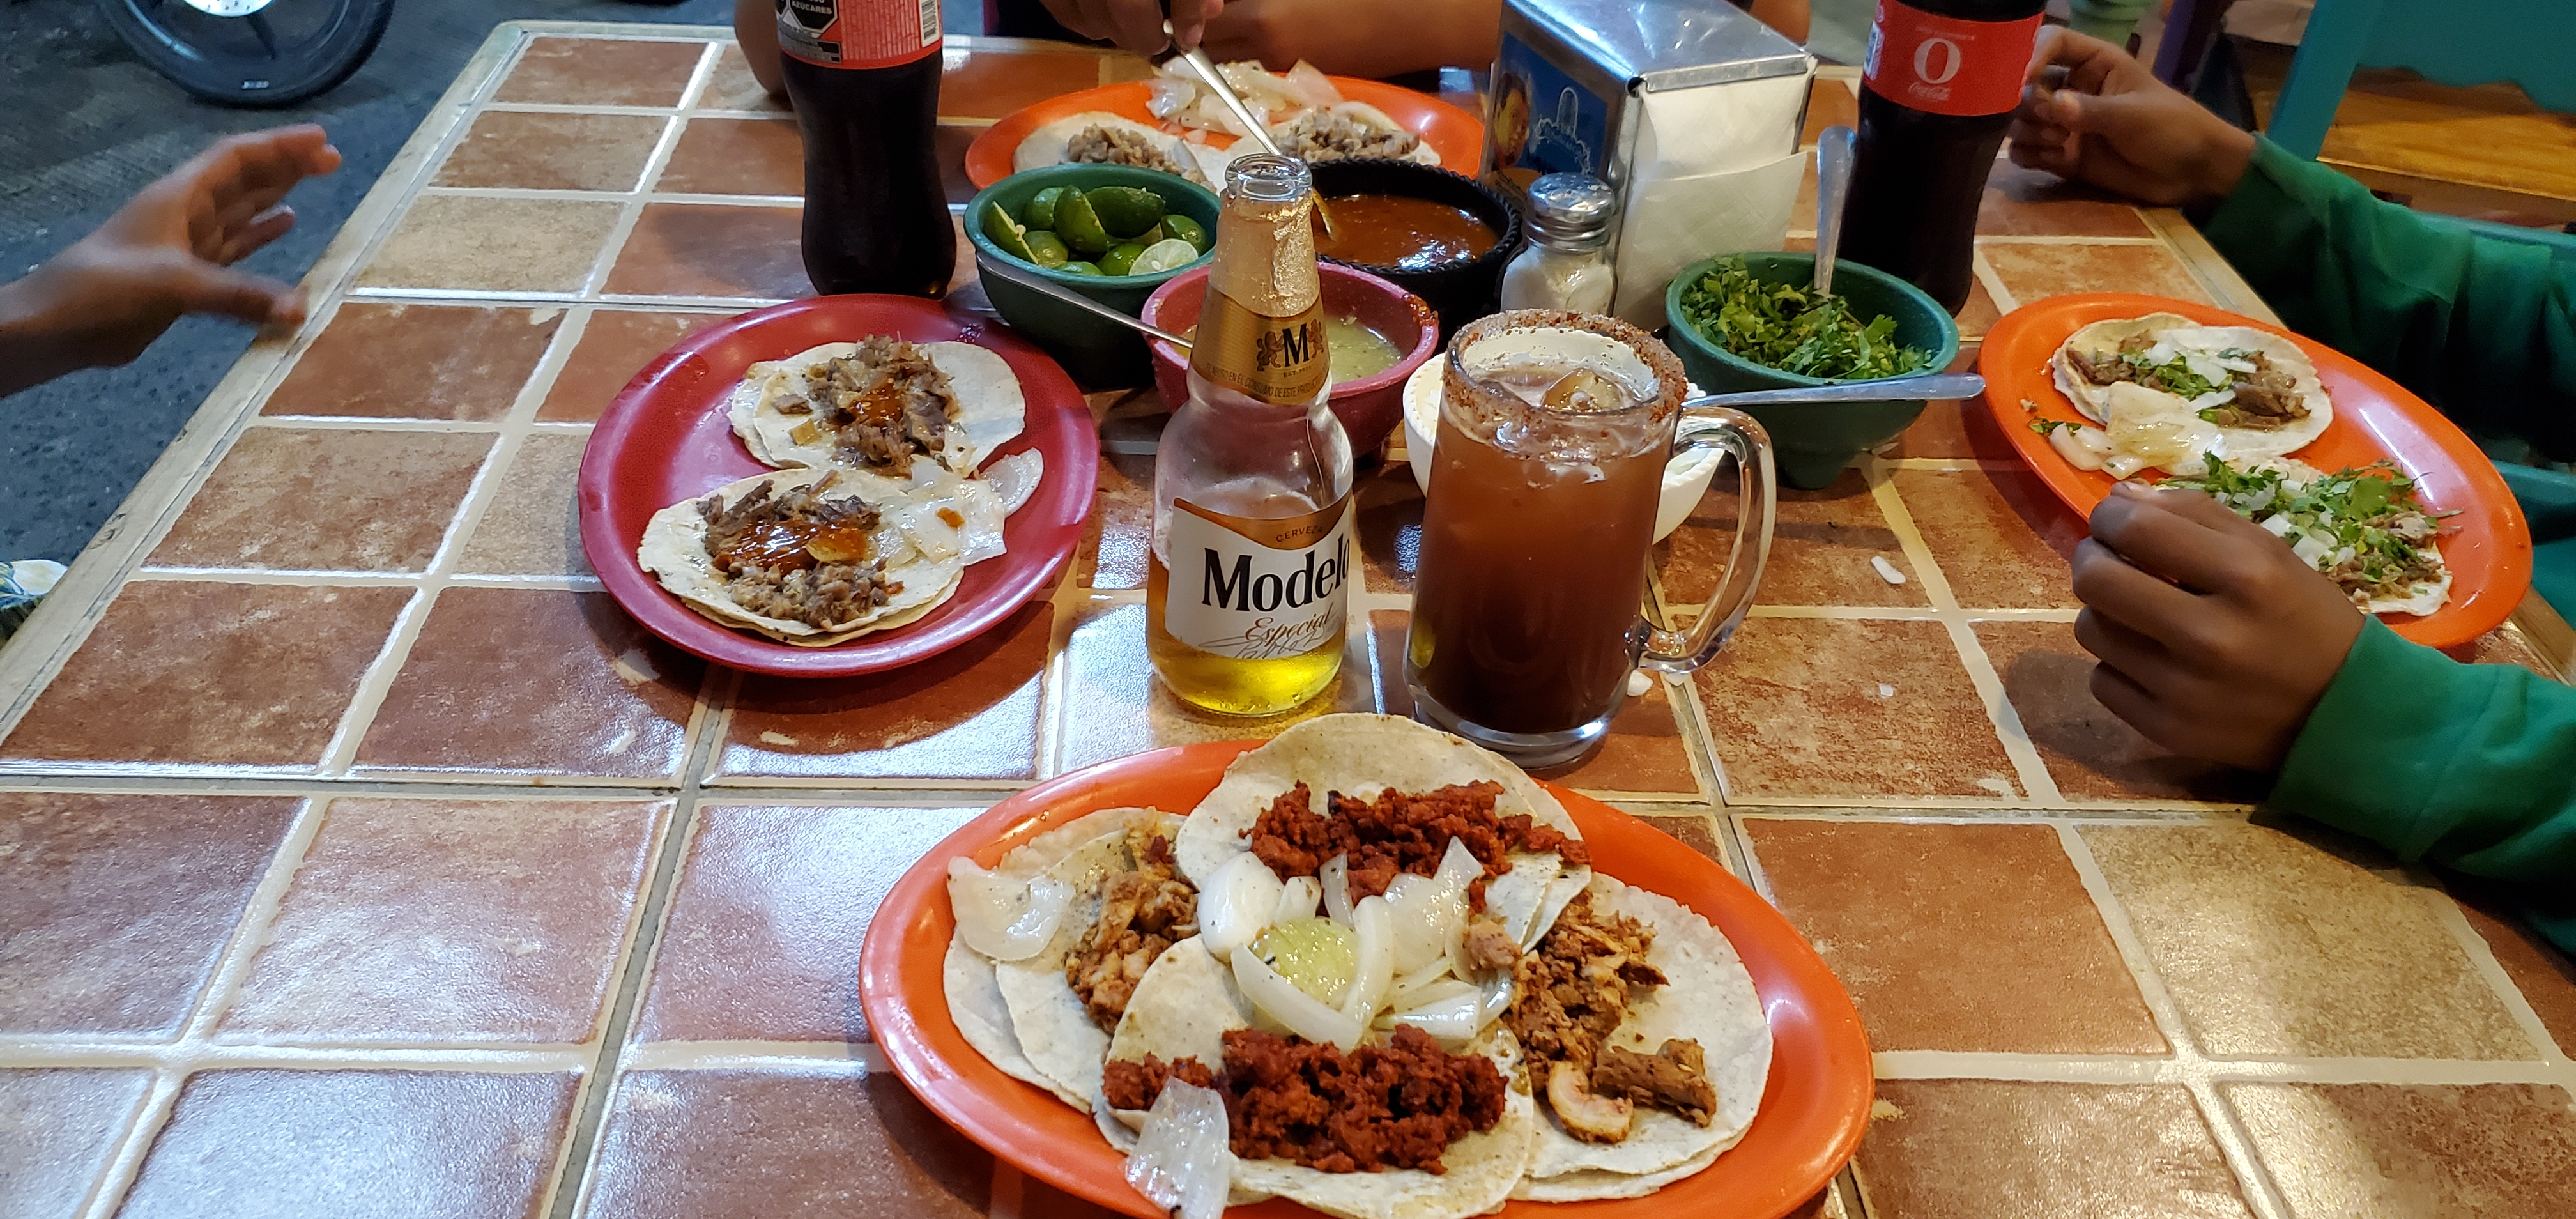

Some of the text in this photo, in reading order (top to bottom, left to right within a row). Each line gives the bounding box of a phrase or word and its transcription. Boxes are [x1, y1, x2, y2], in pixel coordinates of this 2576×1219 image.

[1282, 323, 1310, 367] M
[1229, 371, 1238, 383] EN
[1245, 377, 1275, 397] CONSUMO
[1274, 387, 1282, 397] DE
[1282, 387, 1296, 397] ESTE
[1276, 525, 1322, 542] CERVEZA
[1245, 601, 1333, 647] Especial
